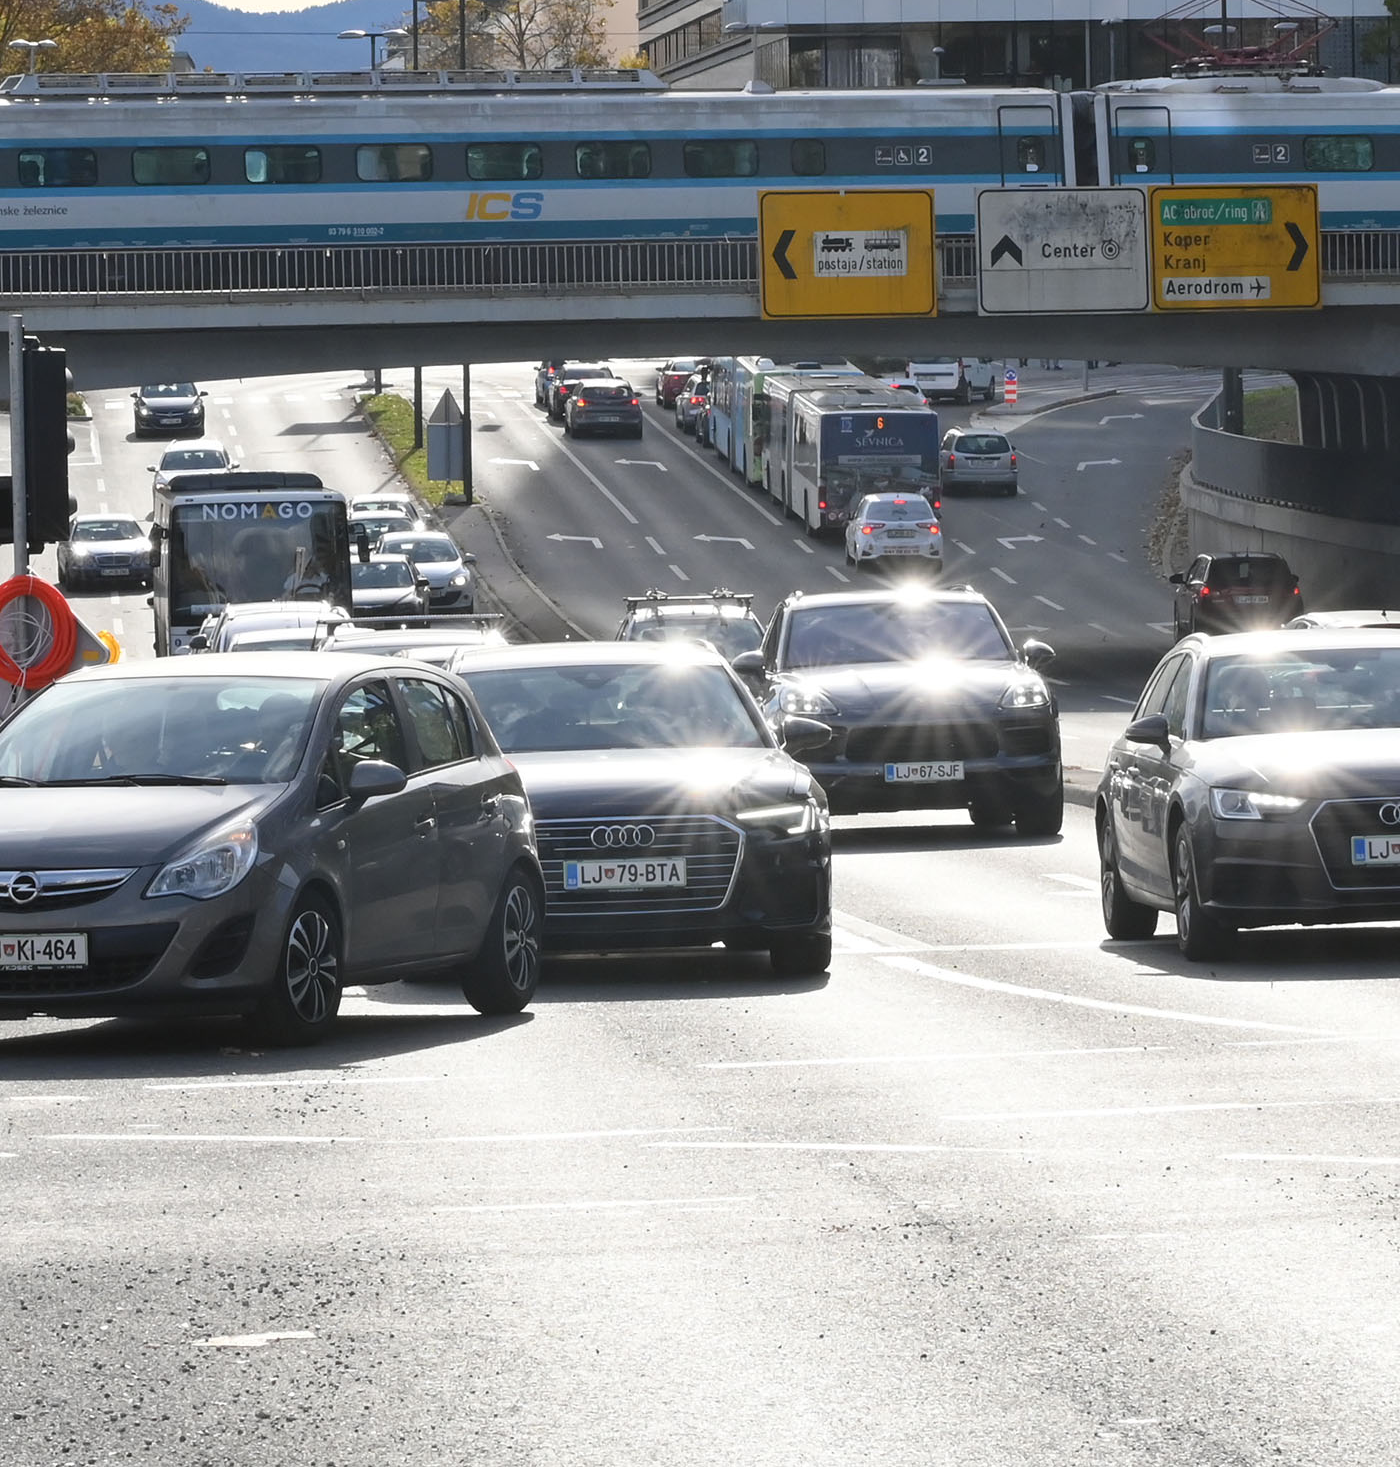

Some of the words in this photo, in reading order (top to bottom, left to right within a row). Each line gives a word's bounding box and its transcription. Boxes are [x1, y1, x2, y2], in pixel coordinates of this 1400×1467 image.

[918, 148, 928, 162] 2
[1276, 146, 1286, 160] 2
[23, 204, 68, 216] železnice
[465, 192, 544, 220] ICS
[1163, 204, 1178, 220] AC
[1163, 231, 1211, 250] Koper
[1041, 242, 1096, 258] Center
[1163, 254, 1207, 273] Kranj
[1165, 278, 1244, 296] Aerodrom
[876, 416, 885, 430] 6
[202, 501, 313, 521] NOMAGO
[896, 766, 911, 779] LJ
[919, 764, 960, 779] 67-SJF
[1367, 840, 1390, 860] LJ
[581, 865, 603, 885] LJ
[616, 862, 681, 884] 79-BTA
[17, 938, 77, 962] KI-464
